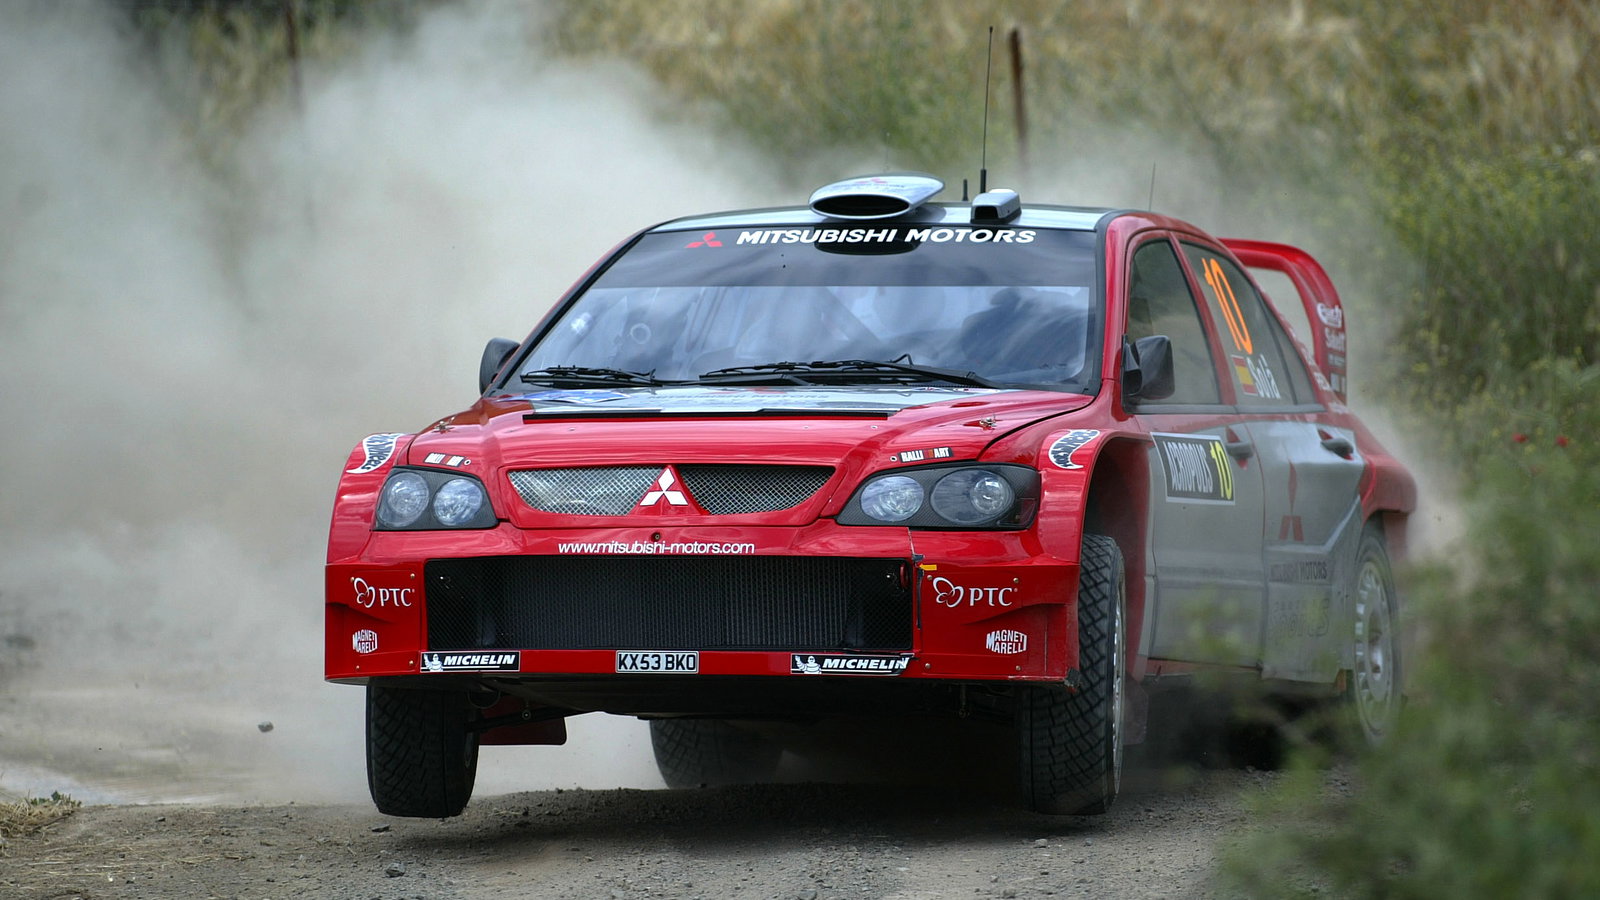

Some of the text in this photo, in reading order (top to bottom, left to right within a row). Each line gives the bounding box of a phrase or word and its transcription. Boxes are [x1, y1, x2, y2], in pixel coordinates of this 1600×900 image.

[736, 228, 1036, 245] MITSUBISHI MOTORS
[1201, 257, 1253, 355] 10
[1163, 441, 1232, 500] ACROPOLIS 10
[558, 541, 755, 555] www.mitsubishi-motors.com
[379, 588, 412, 607] PTC
[969, 587, 1013, 607] PTC
[443, 655, 516, 666] MICHELIN
[618, 653, 697, 671] KX53 BKO
[822, 657, 910, 670] MICHELIN
